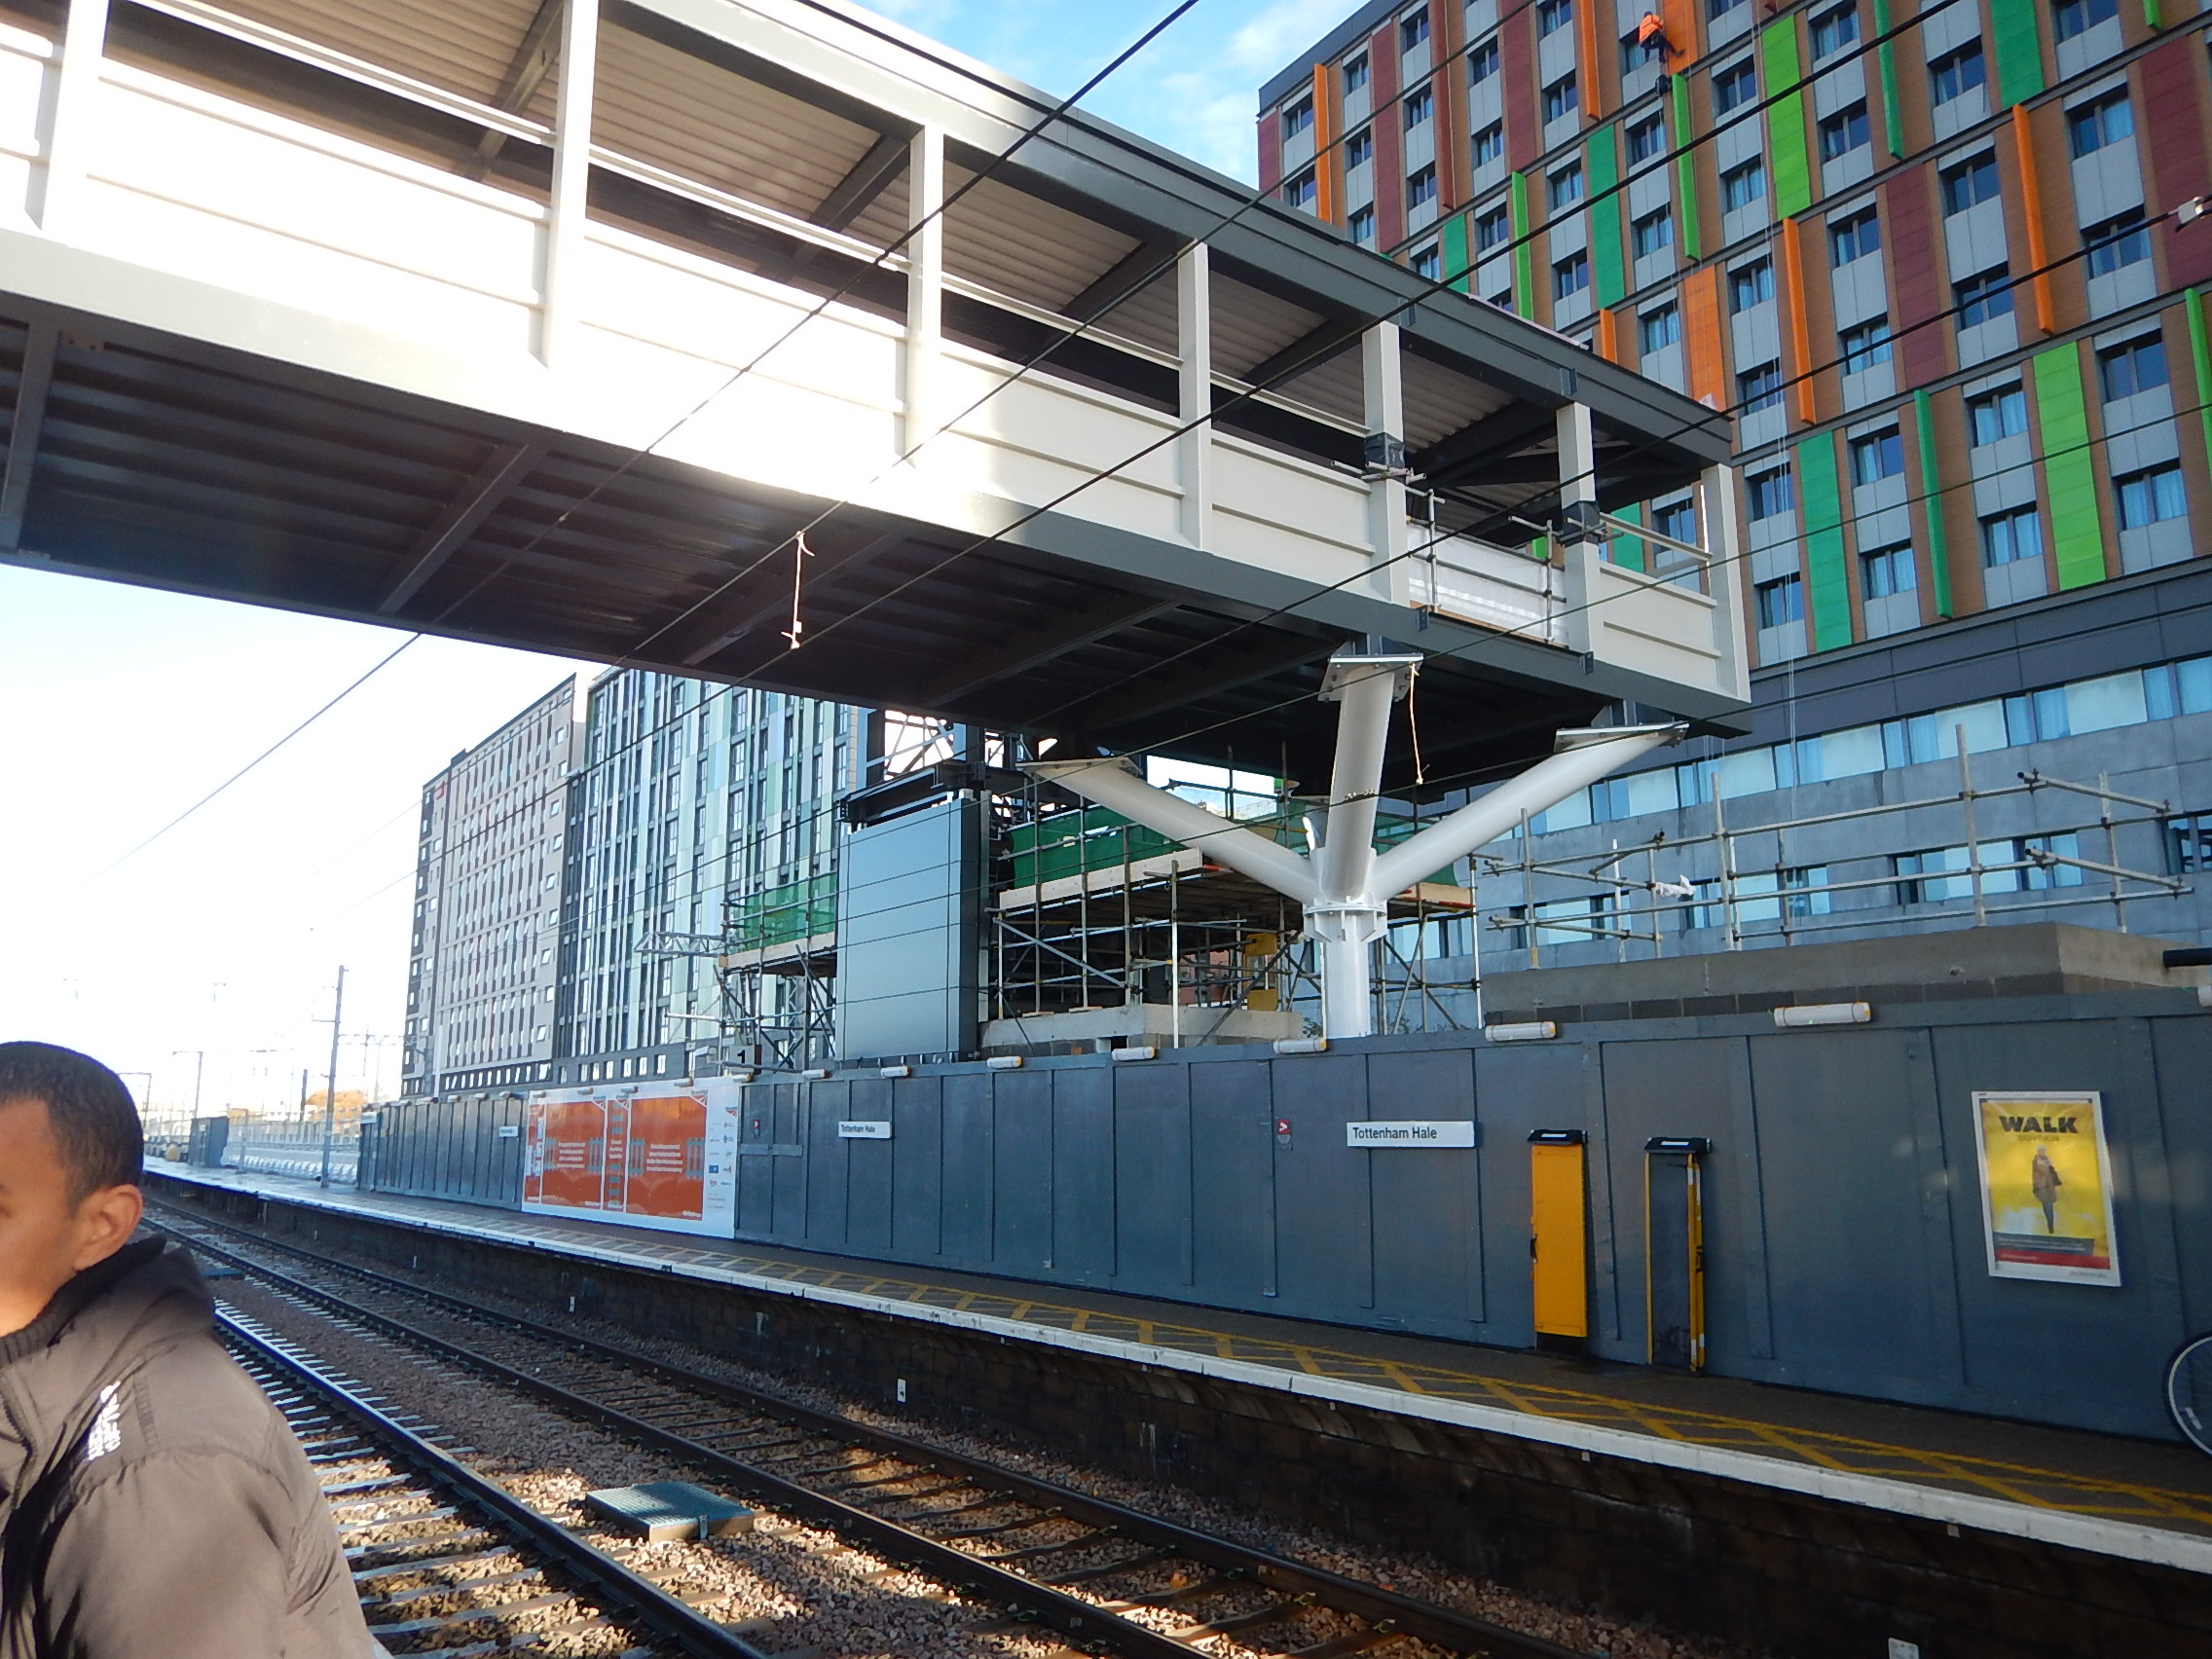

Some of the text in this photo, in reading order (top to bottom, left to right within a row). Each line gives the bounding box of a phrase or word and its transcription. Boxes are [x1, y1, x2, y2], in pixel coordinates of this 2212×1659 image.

[737, 1050, 746, 1064] 1
[840, 1124, 875, 1133] Tottenham Hale
[1999, 1116, 2079, 1133] WALK
[1352, 1126, 1437, 1139] Tottenham Hale
